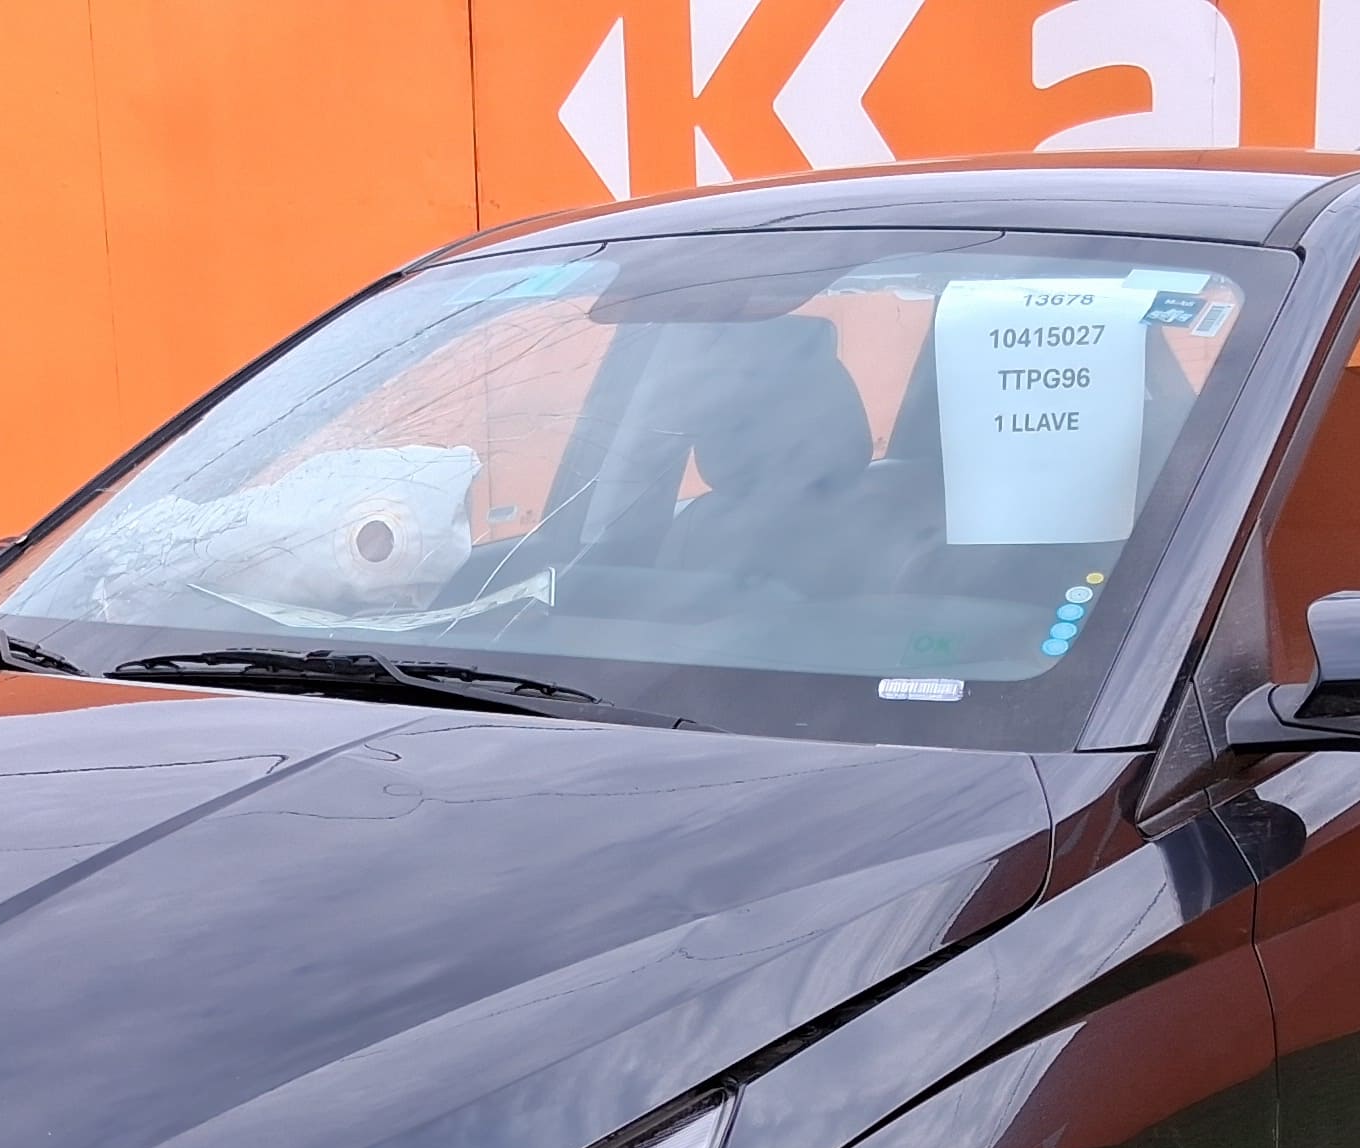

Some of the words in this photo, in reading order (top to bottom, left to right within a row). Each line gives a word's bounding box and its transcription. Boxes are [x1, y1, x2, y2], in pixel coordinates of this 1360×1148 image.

[1023, 294, 1095, 307] 13678
[989, 324, 1105, 349] 10415027
[997, 367, 1090, 391] TTPG96
[994, 415, 1003, 432] 1
[1012, 411, 1080, 432] LLAVE
